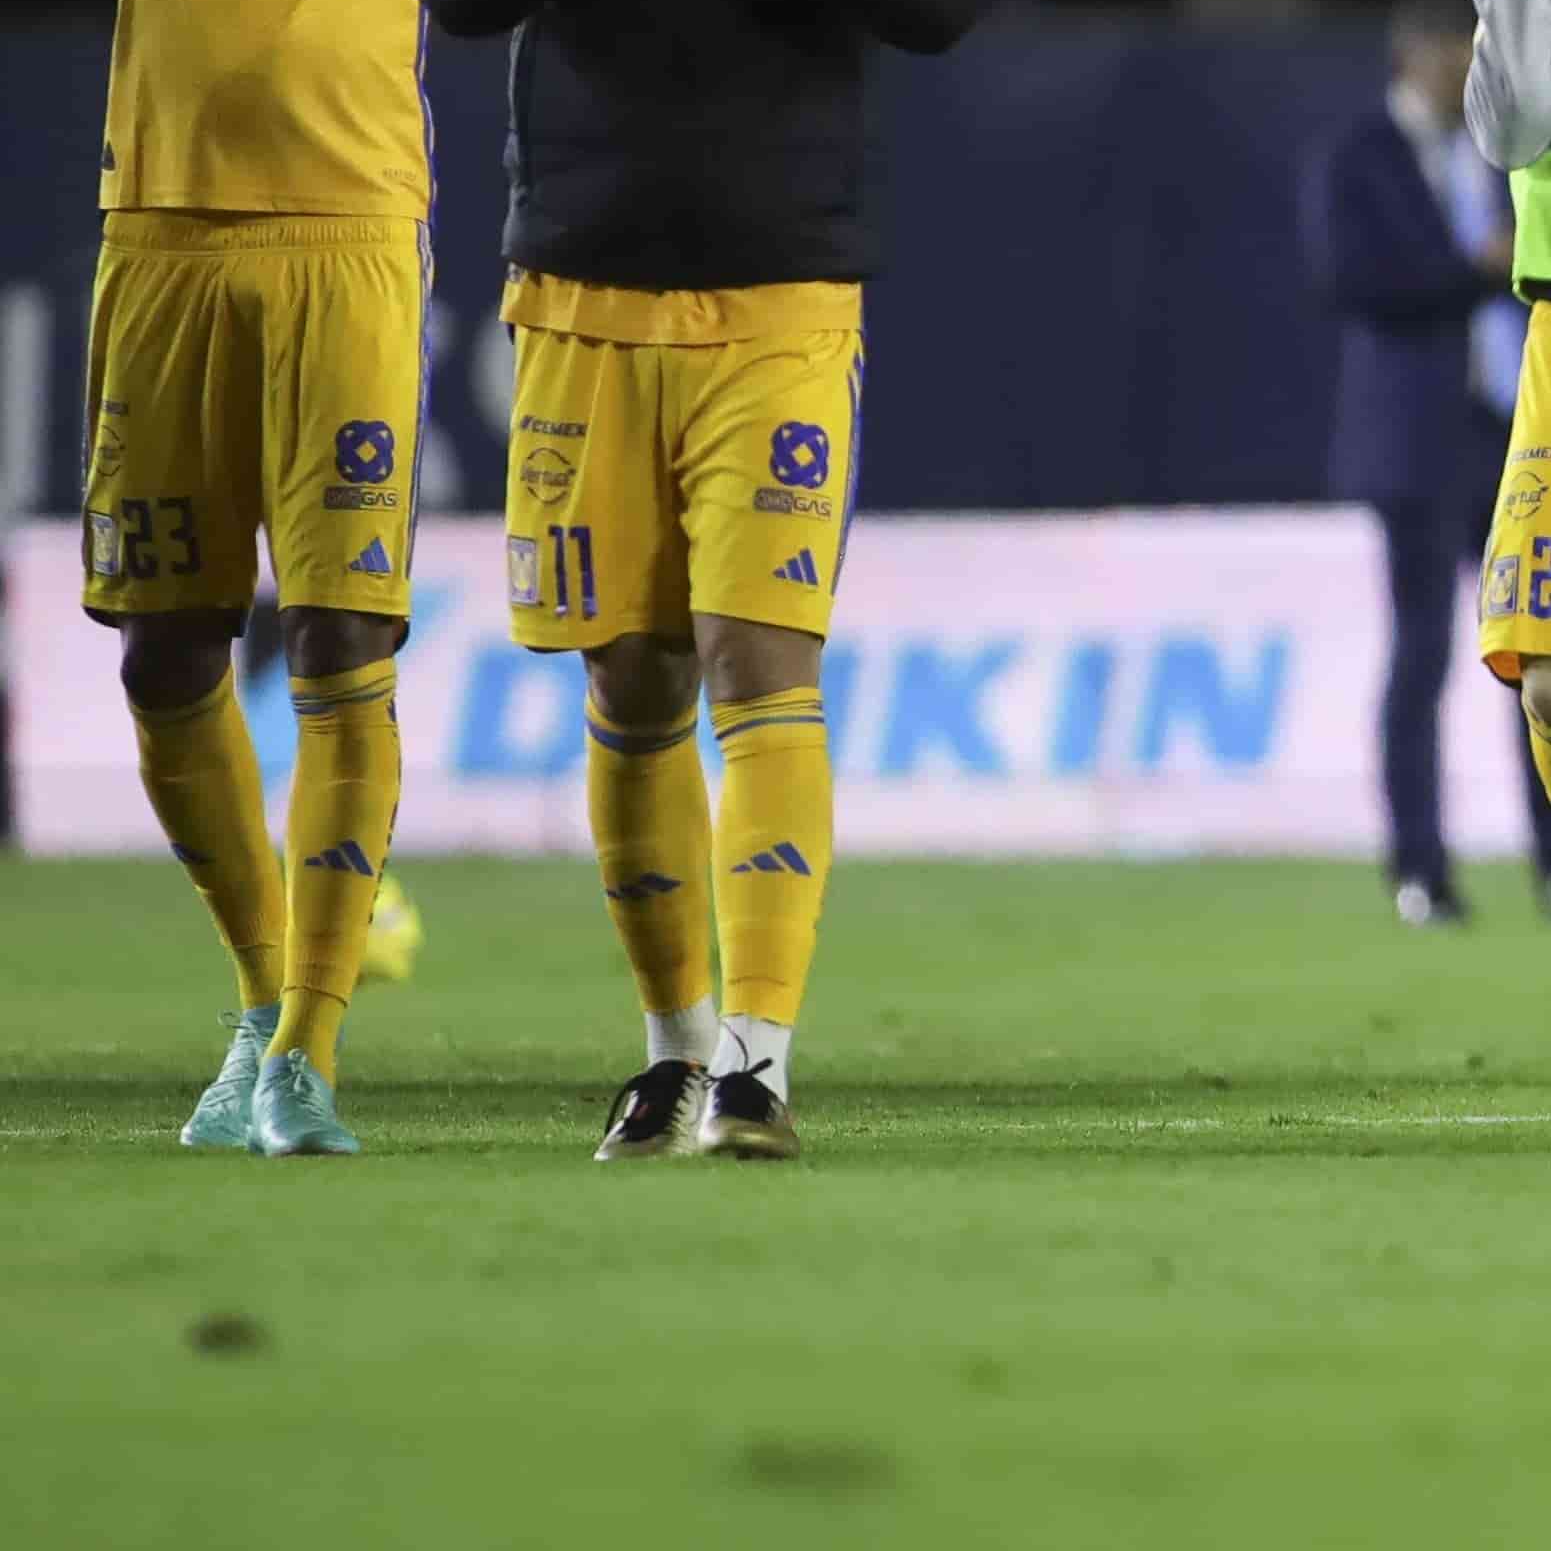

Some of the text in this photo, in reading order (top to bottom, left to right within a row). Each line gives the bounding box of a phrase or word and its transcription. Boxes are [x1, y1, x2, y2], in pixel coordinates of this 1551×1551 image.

[121, 496, 201, 579] 23
[361, 491, 398, 507] GAS
[793, 496, 833, 519] GAS
[548, 524, 597, 622] 11
[452, 635, 1298, 779] DIKIN
